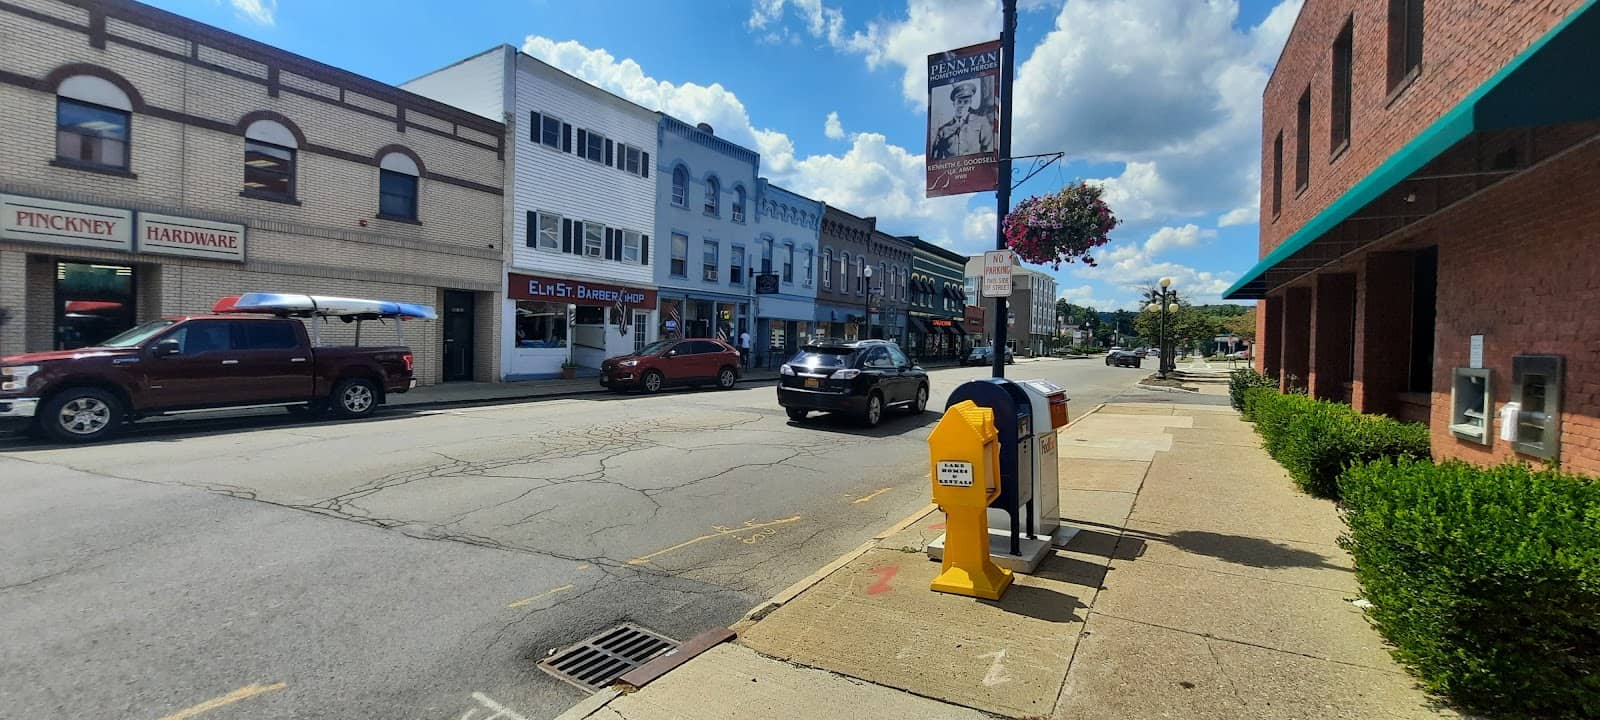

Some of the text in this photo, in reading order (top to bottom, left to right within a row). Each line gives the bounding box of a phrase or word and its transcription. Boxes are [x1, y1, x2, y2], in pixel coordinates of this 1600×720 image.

[930, 62, 998, 81] HOMETOWN HEROES
[931, 51, 997, 75] PENN YAN
[958, 166, 976, 174] ARMY
[16, 211, 116, 236] PINCKNEY
[146, 226, 238, 249] HARDWARE
[993, 255, 1004, 263] NO
[985, 266, 1011, 274] PARKING
[529, 280, 555, 295] ELM
[556, 282, 576, 298] ST.
[577, 285, 620, 302] BARBER
